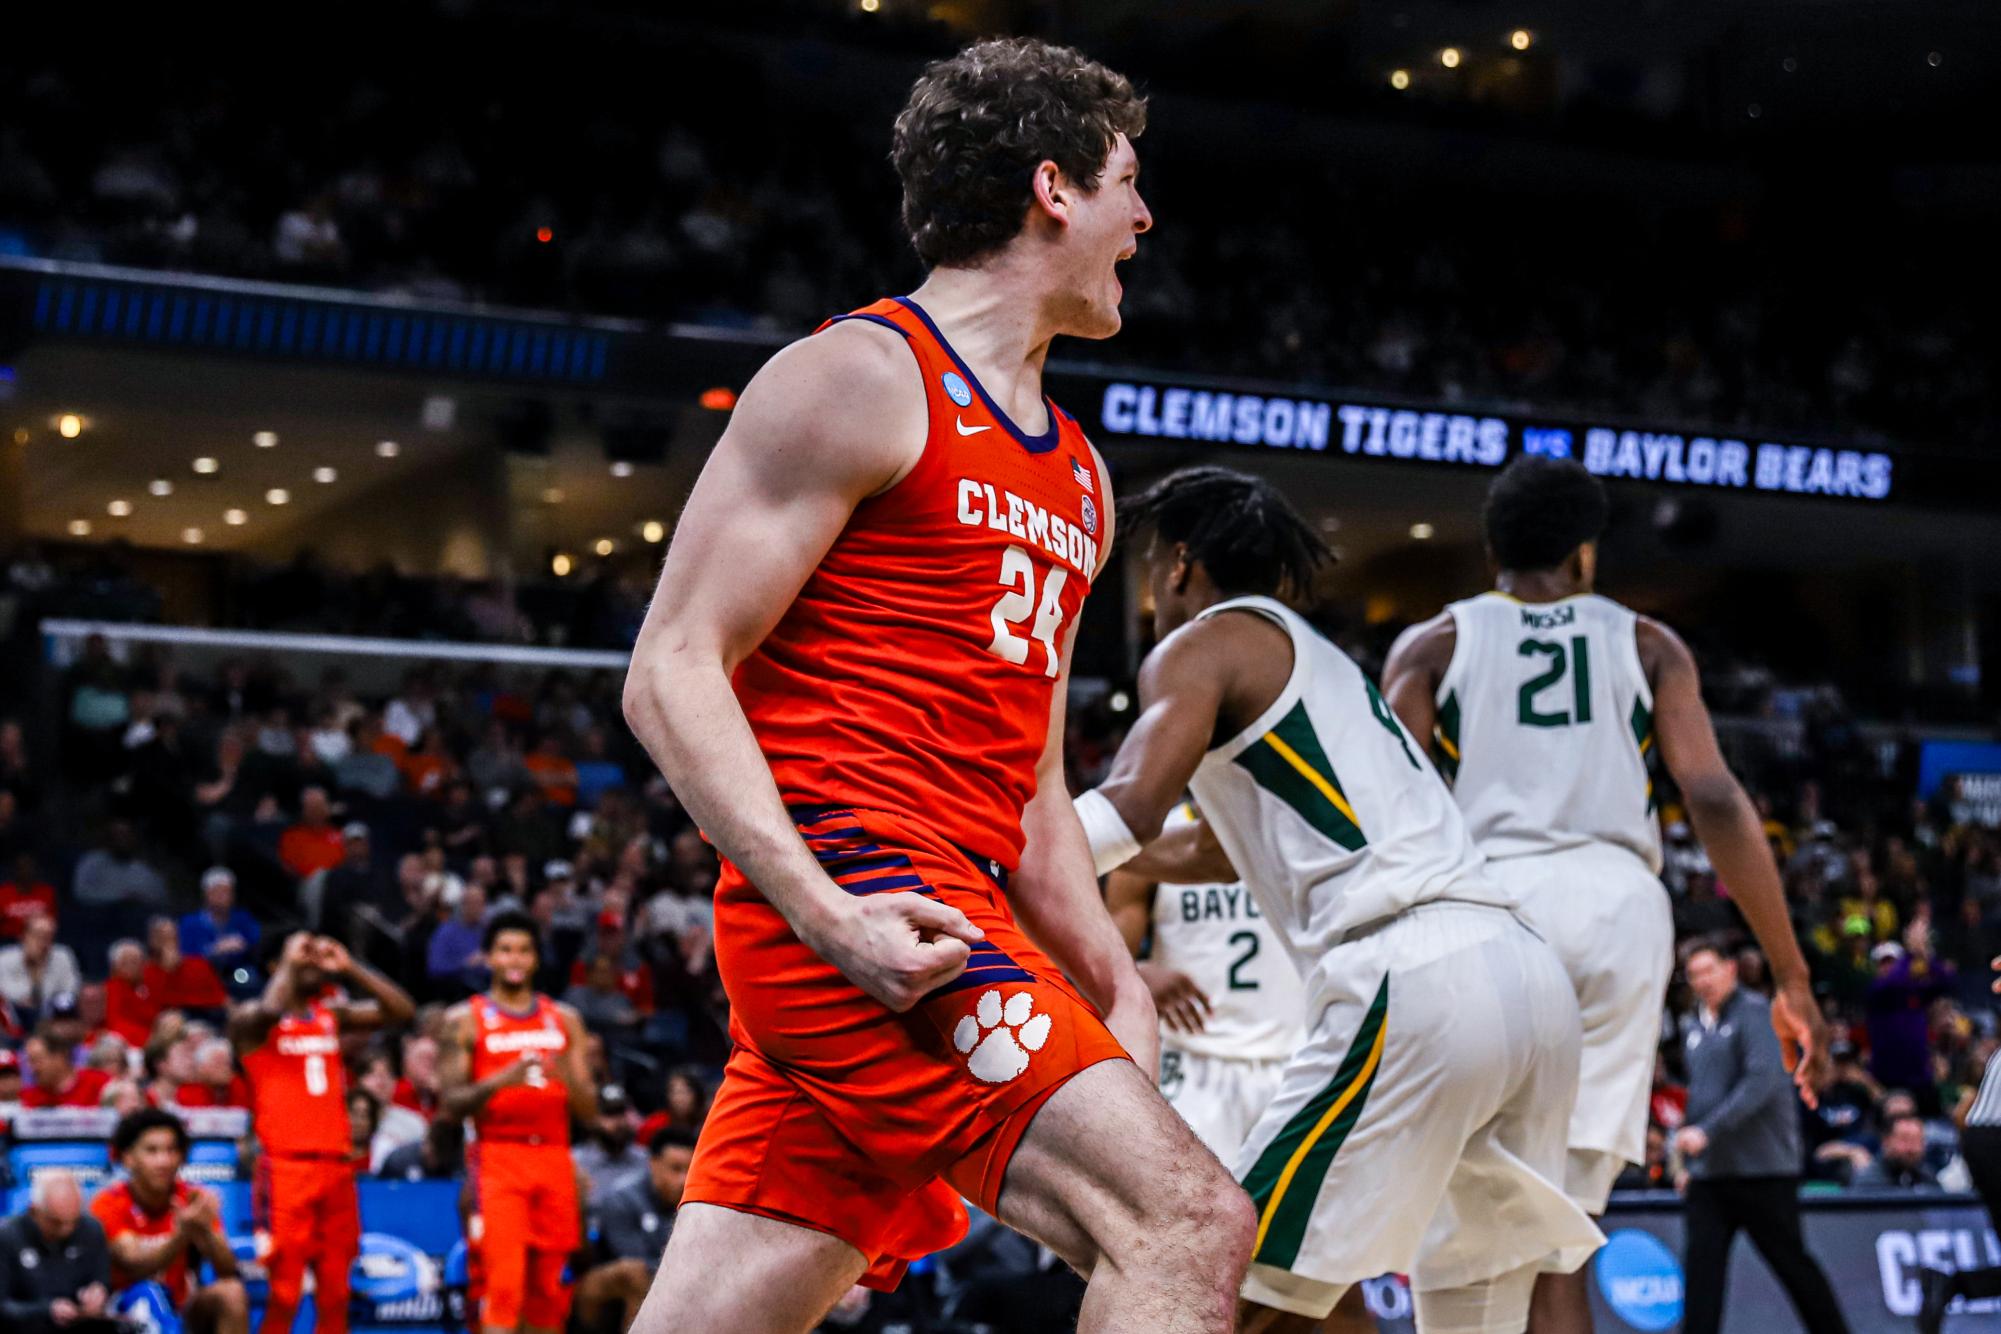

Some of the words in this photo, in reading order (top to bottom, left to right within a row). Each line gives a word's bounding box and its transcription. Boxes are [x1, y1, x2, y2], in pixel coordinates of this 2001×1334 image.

[1102, 383, 1331, 451] CLEMSON
[1338, 404, 1508, 466] TIGERS
[1583, 427, 1749, 487] BAYLOR
[1754, 443, 1893, 499] BEARS
[957, 478, 1098, 585] CLEMSON
[986, 543, 1069, 679] 24
[1518, 635, 1592, 727] 21
[1228, 930, 1261, 990] 2
